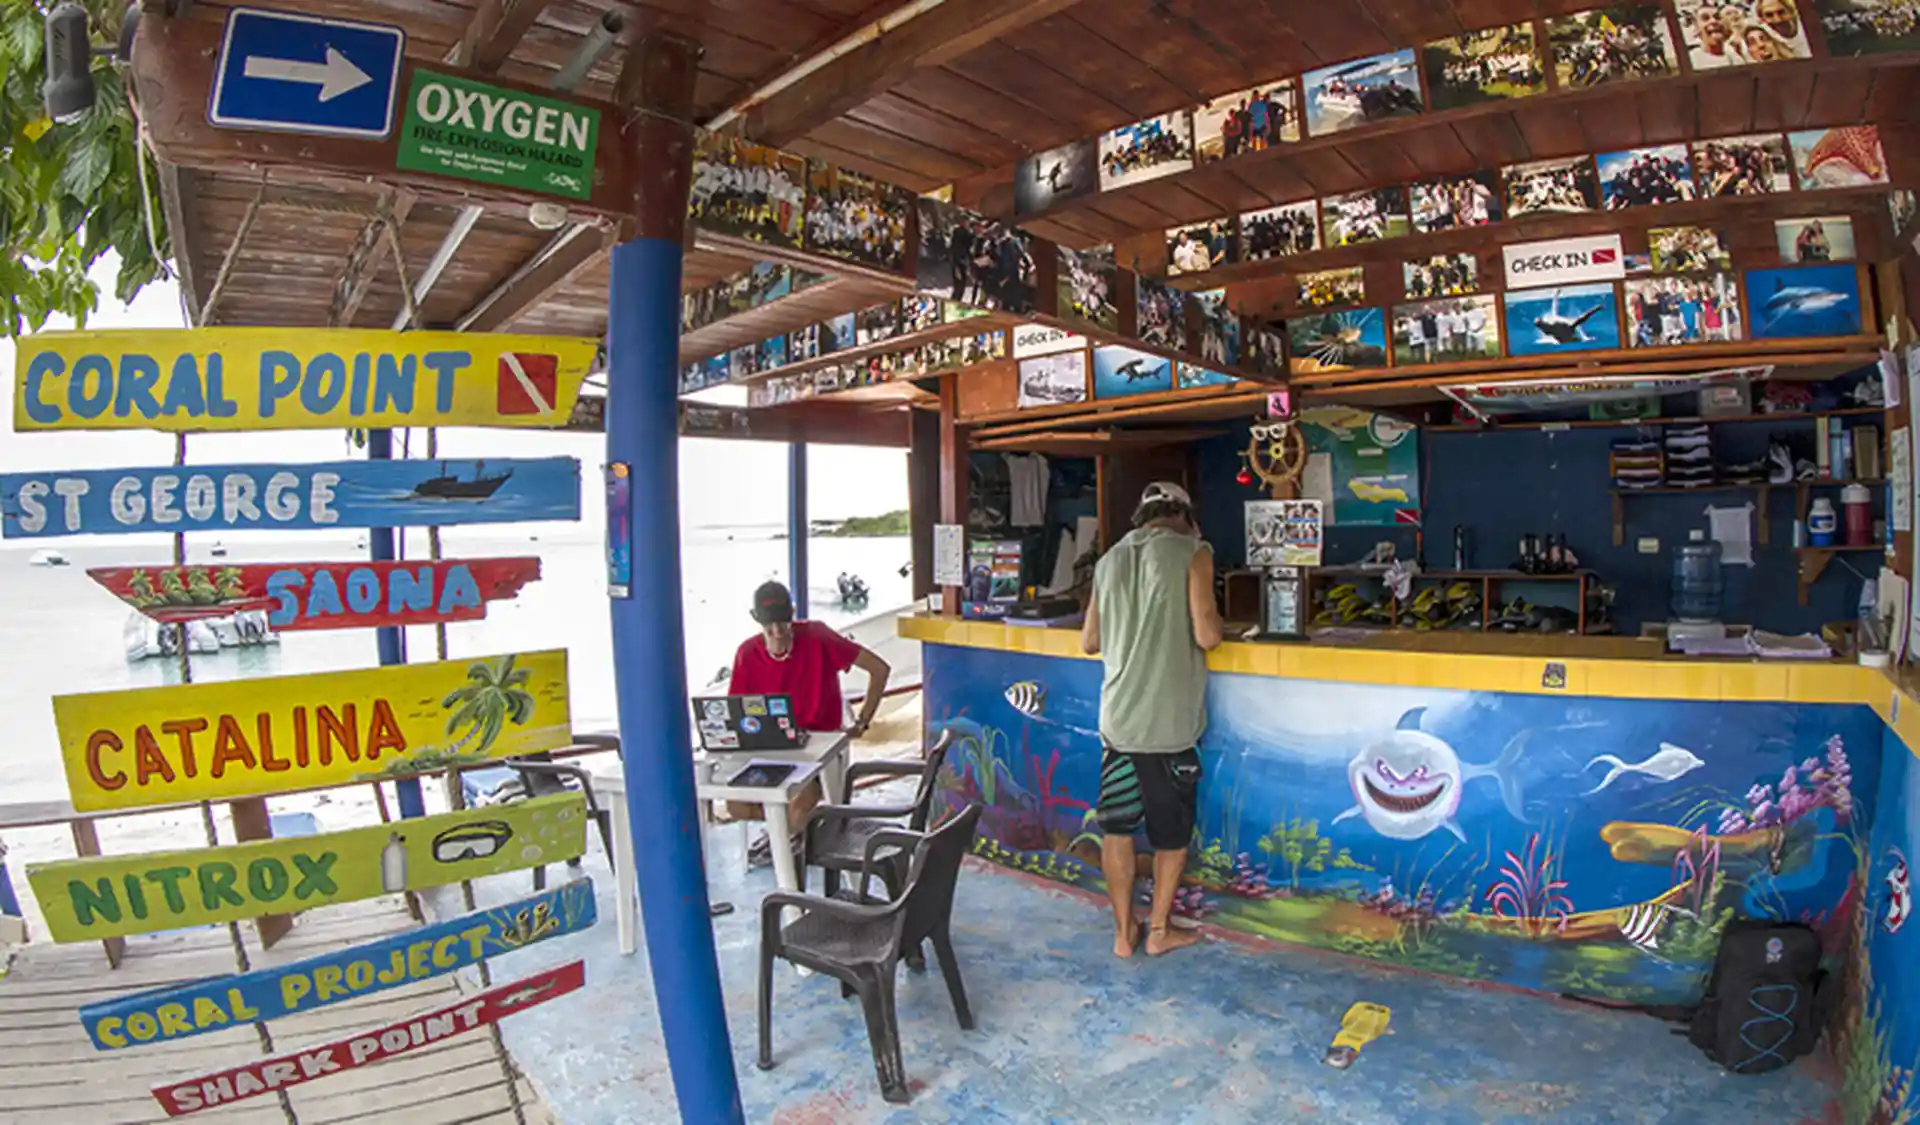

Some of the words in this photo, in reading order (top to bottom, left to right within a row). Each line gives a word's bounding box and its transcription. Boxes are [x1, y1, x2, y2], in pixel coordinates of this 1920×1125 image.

[416, 83, 590, 151] OXYGEN
[528, 146, 583, 168] HAZARD
[1511, 254, 1562, 273] CHECK
[1565, 252, 1588, 269] IN
[1017, 331, 1048, 347] CHECK
[24, 350, 237, 424] CORAL
[258, 350, 472, 419] POINT
[18, 478, 90, 533] ST
[110, 472, 341, 528] GEORGE
[265, 565, 483, 627] SAONA
[86, 698, 408, 791] CATALINA
[67, 851, 340, 926] NITROX
[96, 988, 260, 1049] CORAL
[280, 924, 492, 1010] PROJECT
[170, 1046, 342, 1113] SHARK
[350, 999, 486, 1065] POINT
